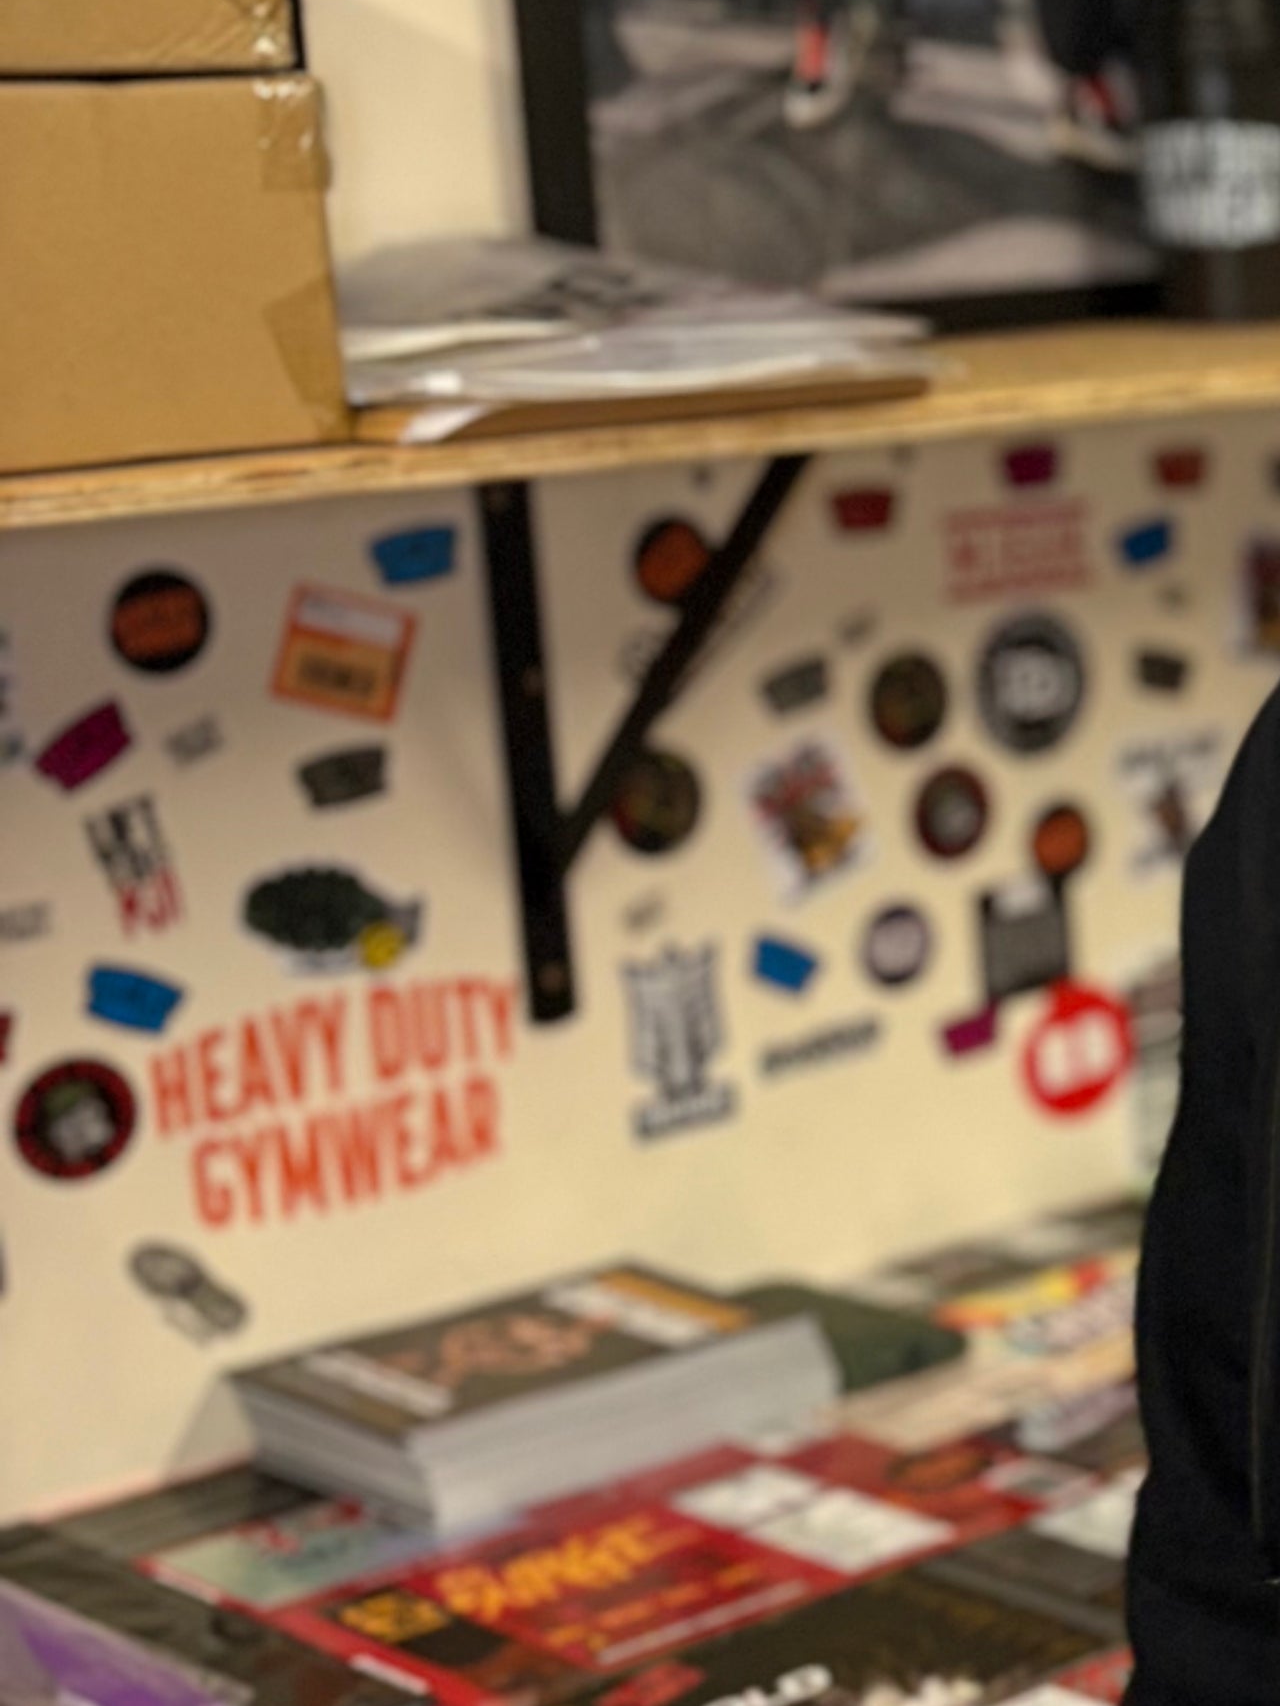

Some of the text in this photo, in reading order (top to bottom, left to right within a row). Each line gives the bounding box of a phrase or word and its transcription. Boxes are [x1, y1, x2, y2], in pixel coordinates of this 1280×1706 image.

[146, 993, 349, 1140] HEAVY
[366, 975, 522, 1083] DUTY
[190, 1072, 502, 1231] GYMWEAR
